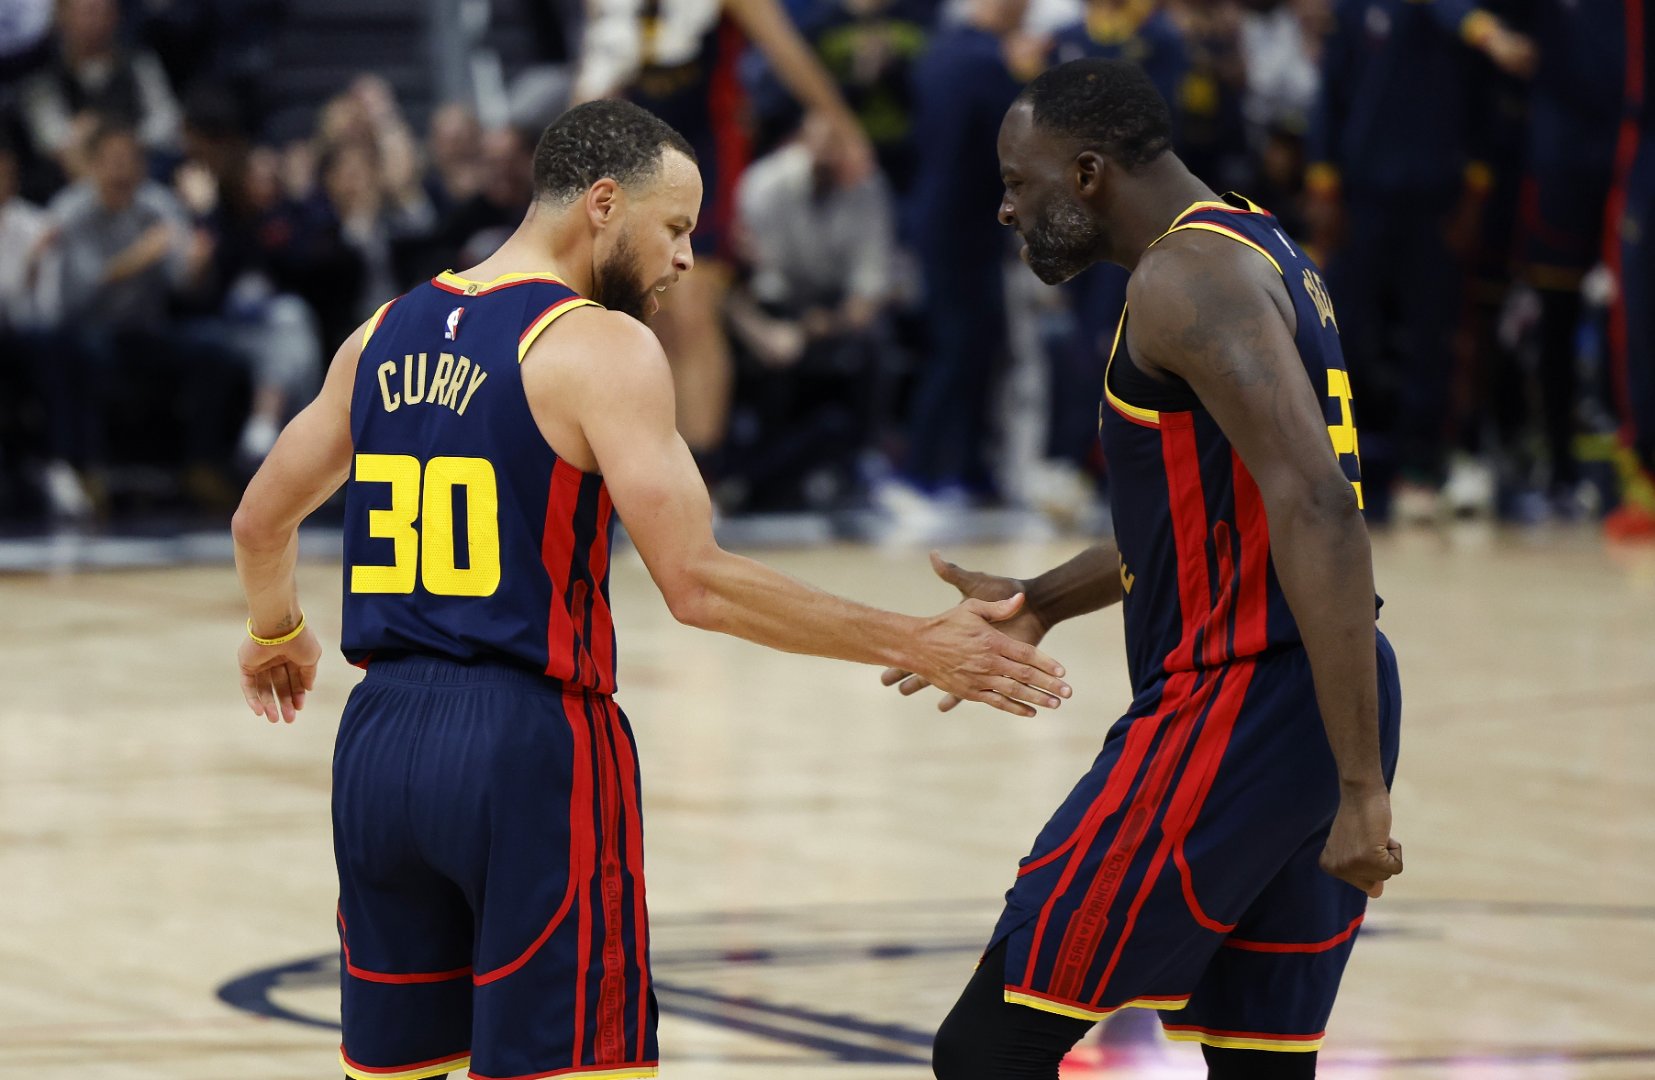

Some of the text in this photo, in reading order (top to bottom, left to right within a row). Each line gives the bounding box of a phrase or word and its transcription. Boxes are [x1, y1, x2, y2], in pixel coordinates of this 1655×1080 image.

[377, 353, 488, 416] CURRY
[351, 453, 501, 597] 30
[606, 880, 618, 936] GOLDEN
[1068, 853, 1125, 964] SAN FRANCISCO
[607, 938, 620, 984] STATE
